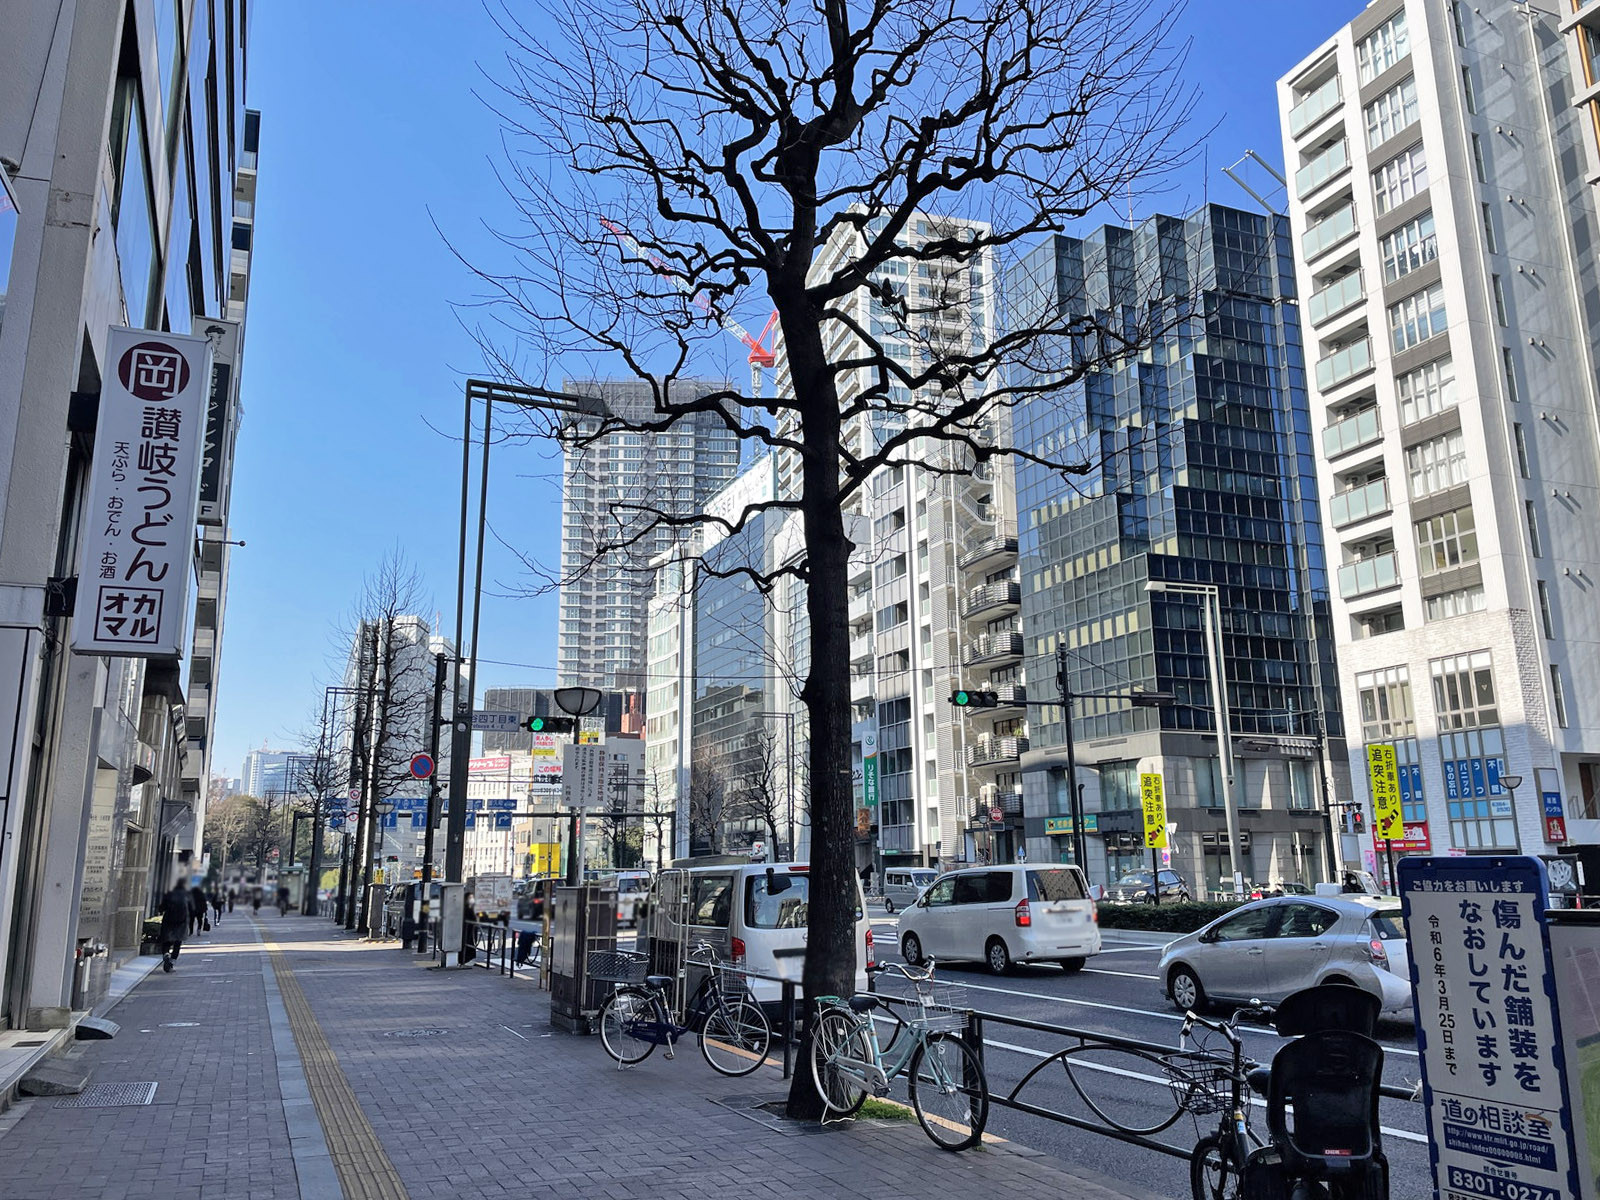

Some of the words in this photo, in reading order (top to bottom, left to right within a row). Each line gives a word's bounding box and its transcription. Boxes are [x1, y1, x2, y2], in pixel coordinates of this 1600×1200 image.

[129, 348, 183, 397] 岡
[125, 406, 182, 582] 讃岐うどん
[1143, 776, 1155, 825] 追突注意
[1371, 748, 1389, 811] 追突注意
[1384, 748, 1397, 806] 右折車あり
[1401, 768, 1411, 800] うつ
[1446, 764, 1458, 797] もの忘れ
[1459, 762, 1470, 796] パニック
[1473, 762, 1484, 794] うつ
[1412, 879, 1524, 893] ご協力をお願いします
[1428, 914, 1457, 1077] 令和6年3月25日まで
[1458, 899, 1502, 1087] なおしています
[1492, 899, 1541, 1093] 傷んだ舗装を
[1483, 1165, 1518, 1180] 問合せ番号
